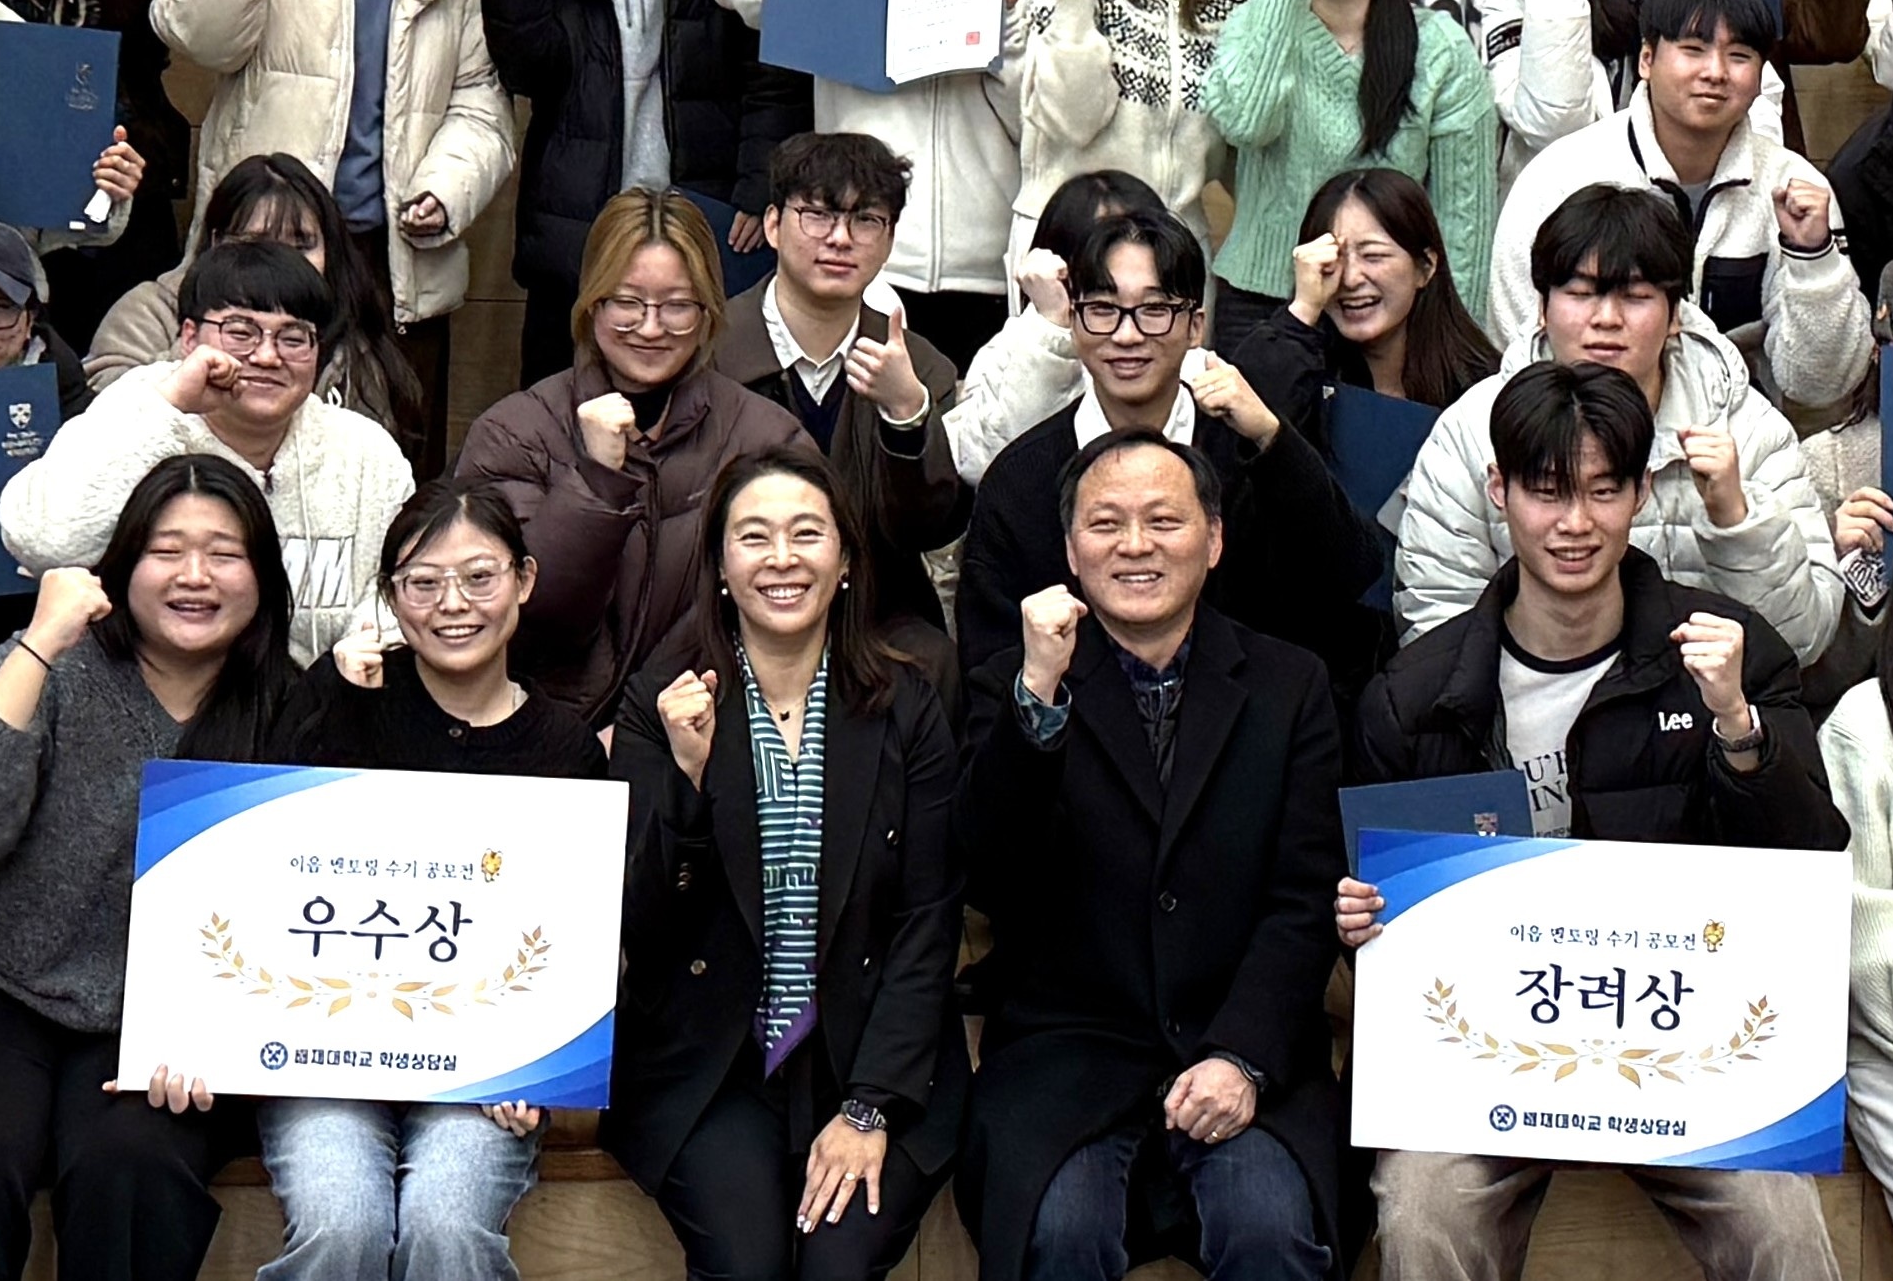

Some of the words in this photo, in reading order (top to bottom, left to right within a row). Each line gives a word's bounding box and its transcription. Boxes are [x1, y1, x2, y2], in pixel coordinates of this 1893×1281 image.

[1658, 711, 1693, 731] Lee
[385, 859, 418, 879] 수기
[287, 895, 474, 963] 우수상
[1607, 929, 1639, 949] 수기
[1515, 962, 1695, 1032] 장려상
